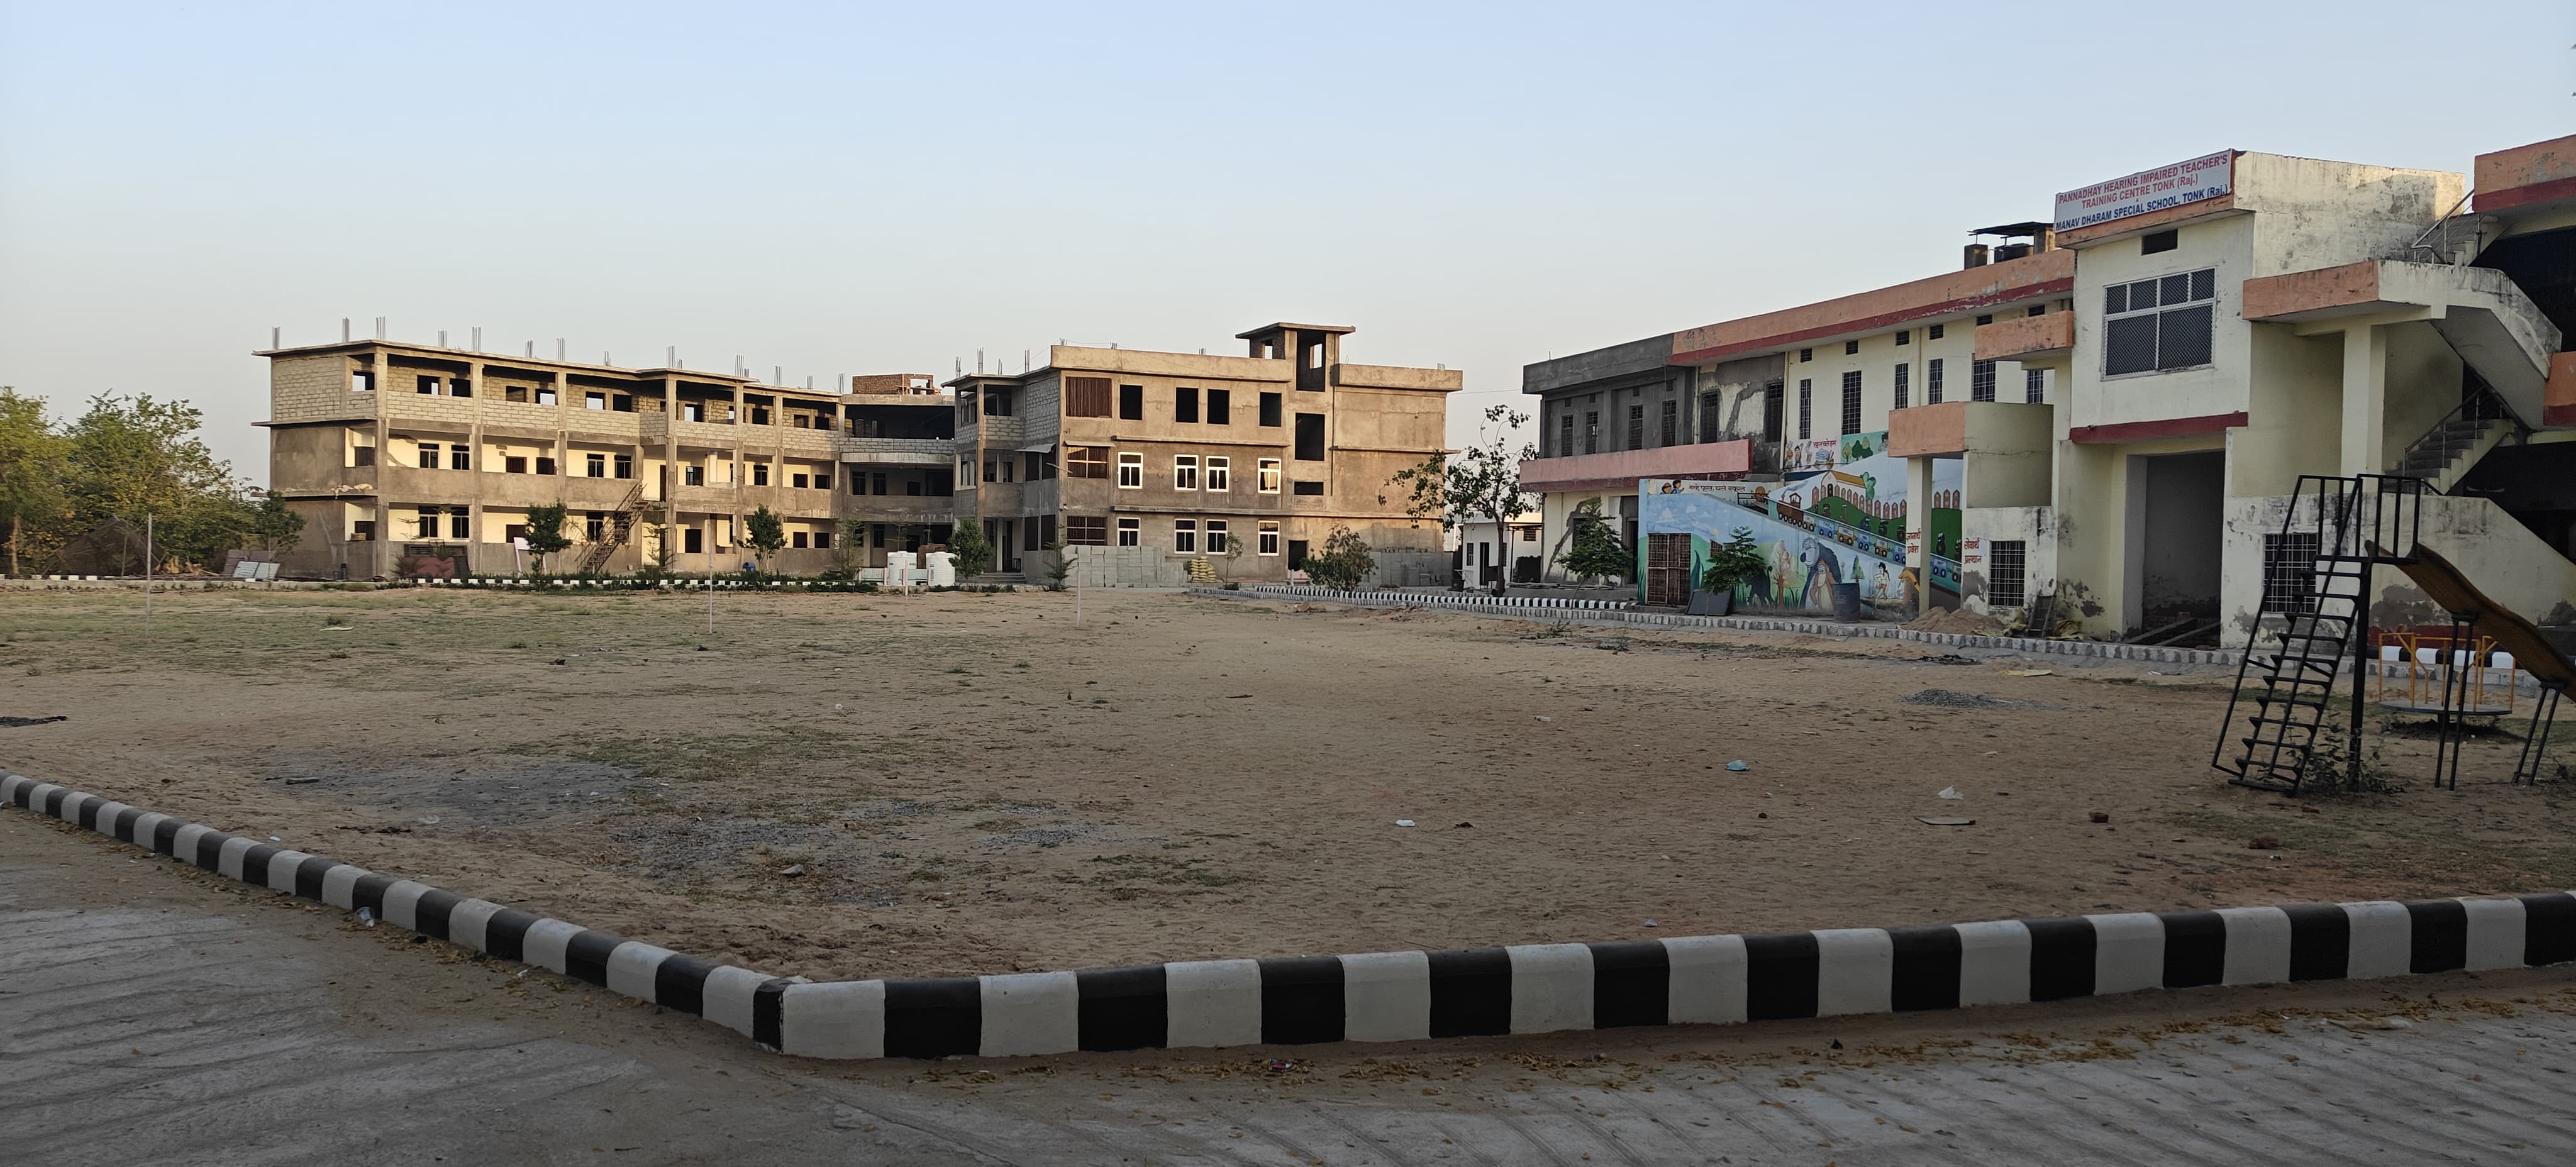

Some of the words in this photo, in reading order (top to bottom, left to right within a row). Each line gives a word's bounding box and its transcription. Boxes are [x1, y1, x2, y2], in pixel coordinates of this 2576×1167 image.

[2058, 185, 2102, 204] PANNADHAY
[2104, 176, 2138, 194] HEARING
[2140, 167, 2178, 184] IMPAIRED
[2180, 154, 2228, 174] TEACHER'S
[2082, 192, 2118, 209] TRAINING
[2119, 185, 2150, 201] CENTRE
[2152, 179, 2175, 194] TONK
[2177, 173, 2198, 189] (Raj.)
[2056, 216, 2080, 231] MANAV
[2082, 210, 2112, 226] DHARAM
[2114, 202, 2145, 218] SPECIAL
[2146, 194, 2180, 211] SCHOOL,
[2183, 189, 2205, 202] TONK
